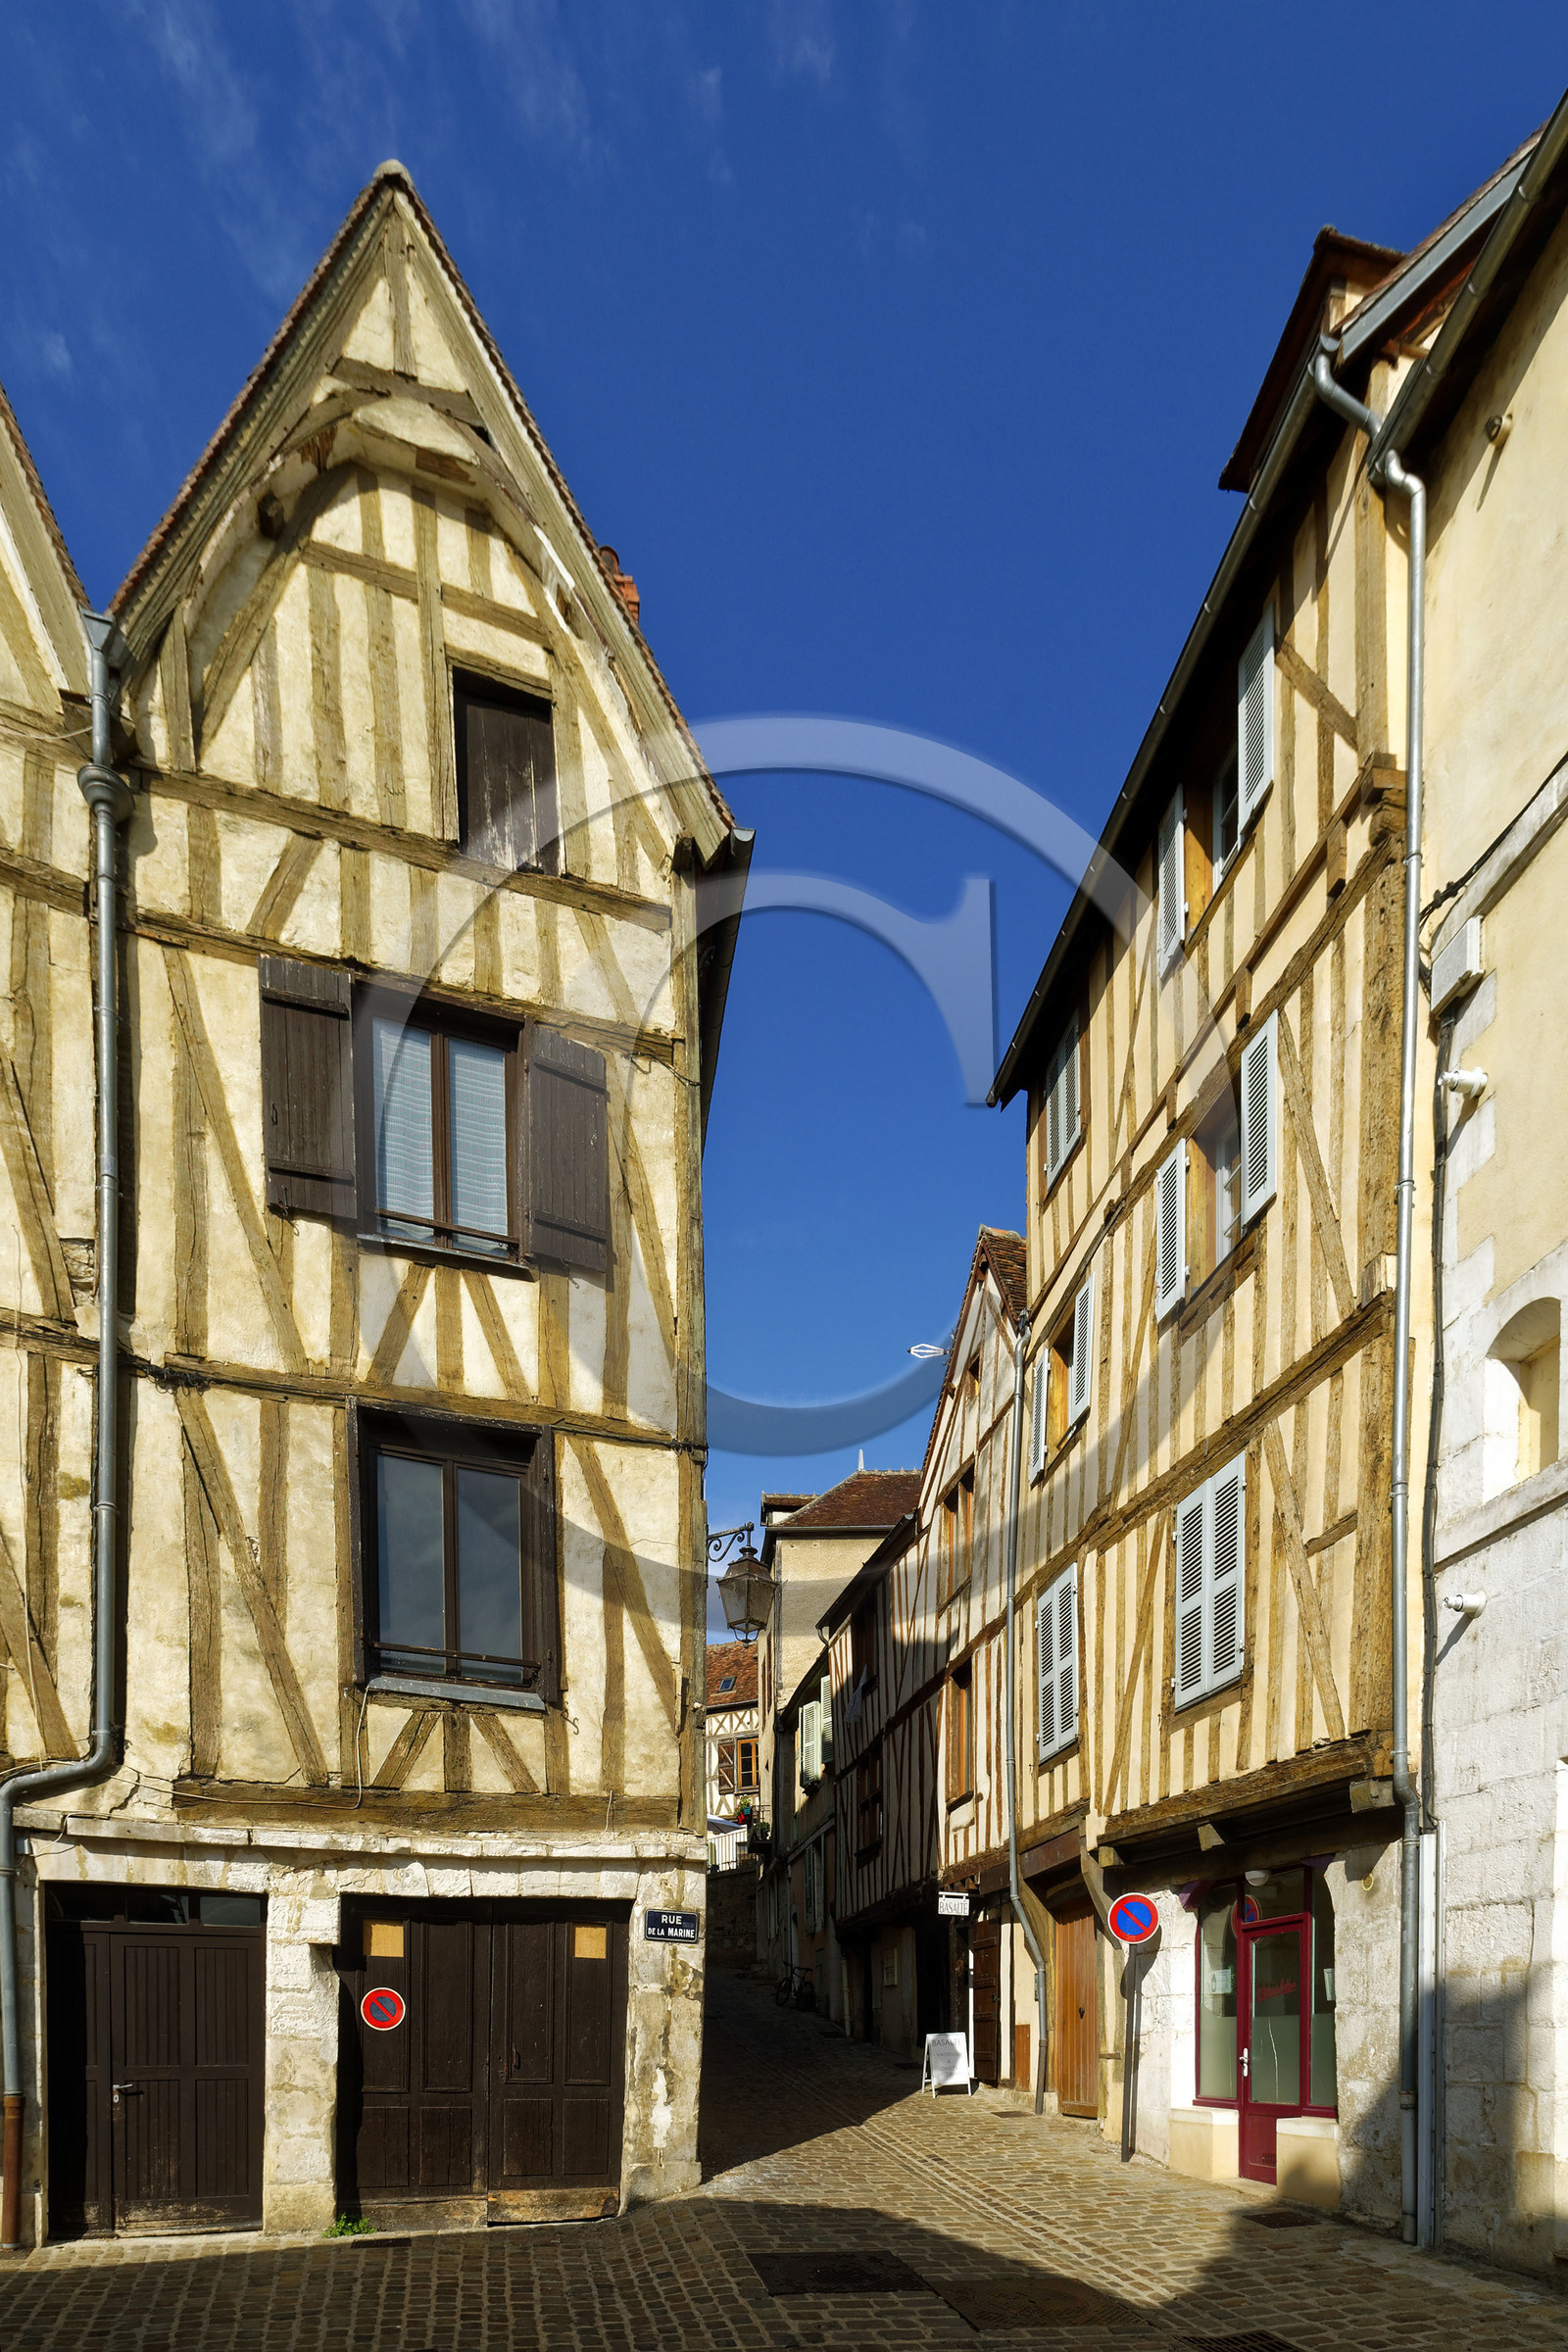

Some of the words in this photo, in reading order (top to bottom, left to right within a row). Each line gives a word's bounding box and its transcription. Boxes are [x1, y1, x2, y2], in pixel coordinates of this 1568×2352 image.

[939, 1901, 968, 1914] BASALTE
[662, 1915, 682, 1925] RUE
[667, 1928, 695, 1937] MARINE
